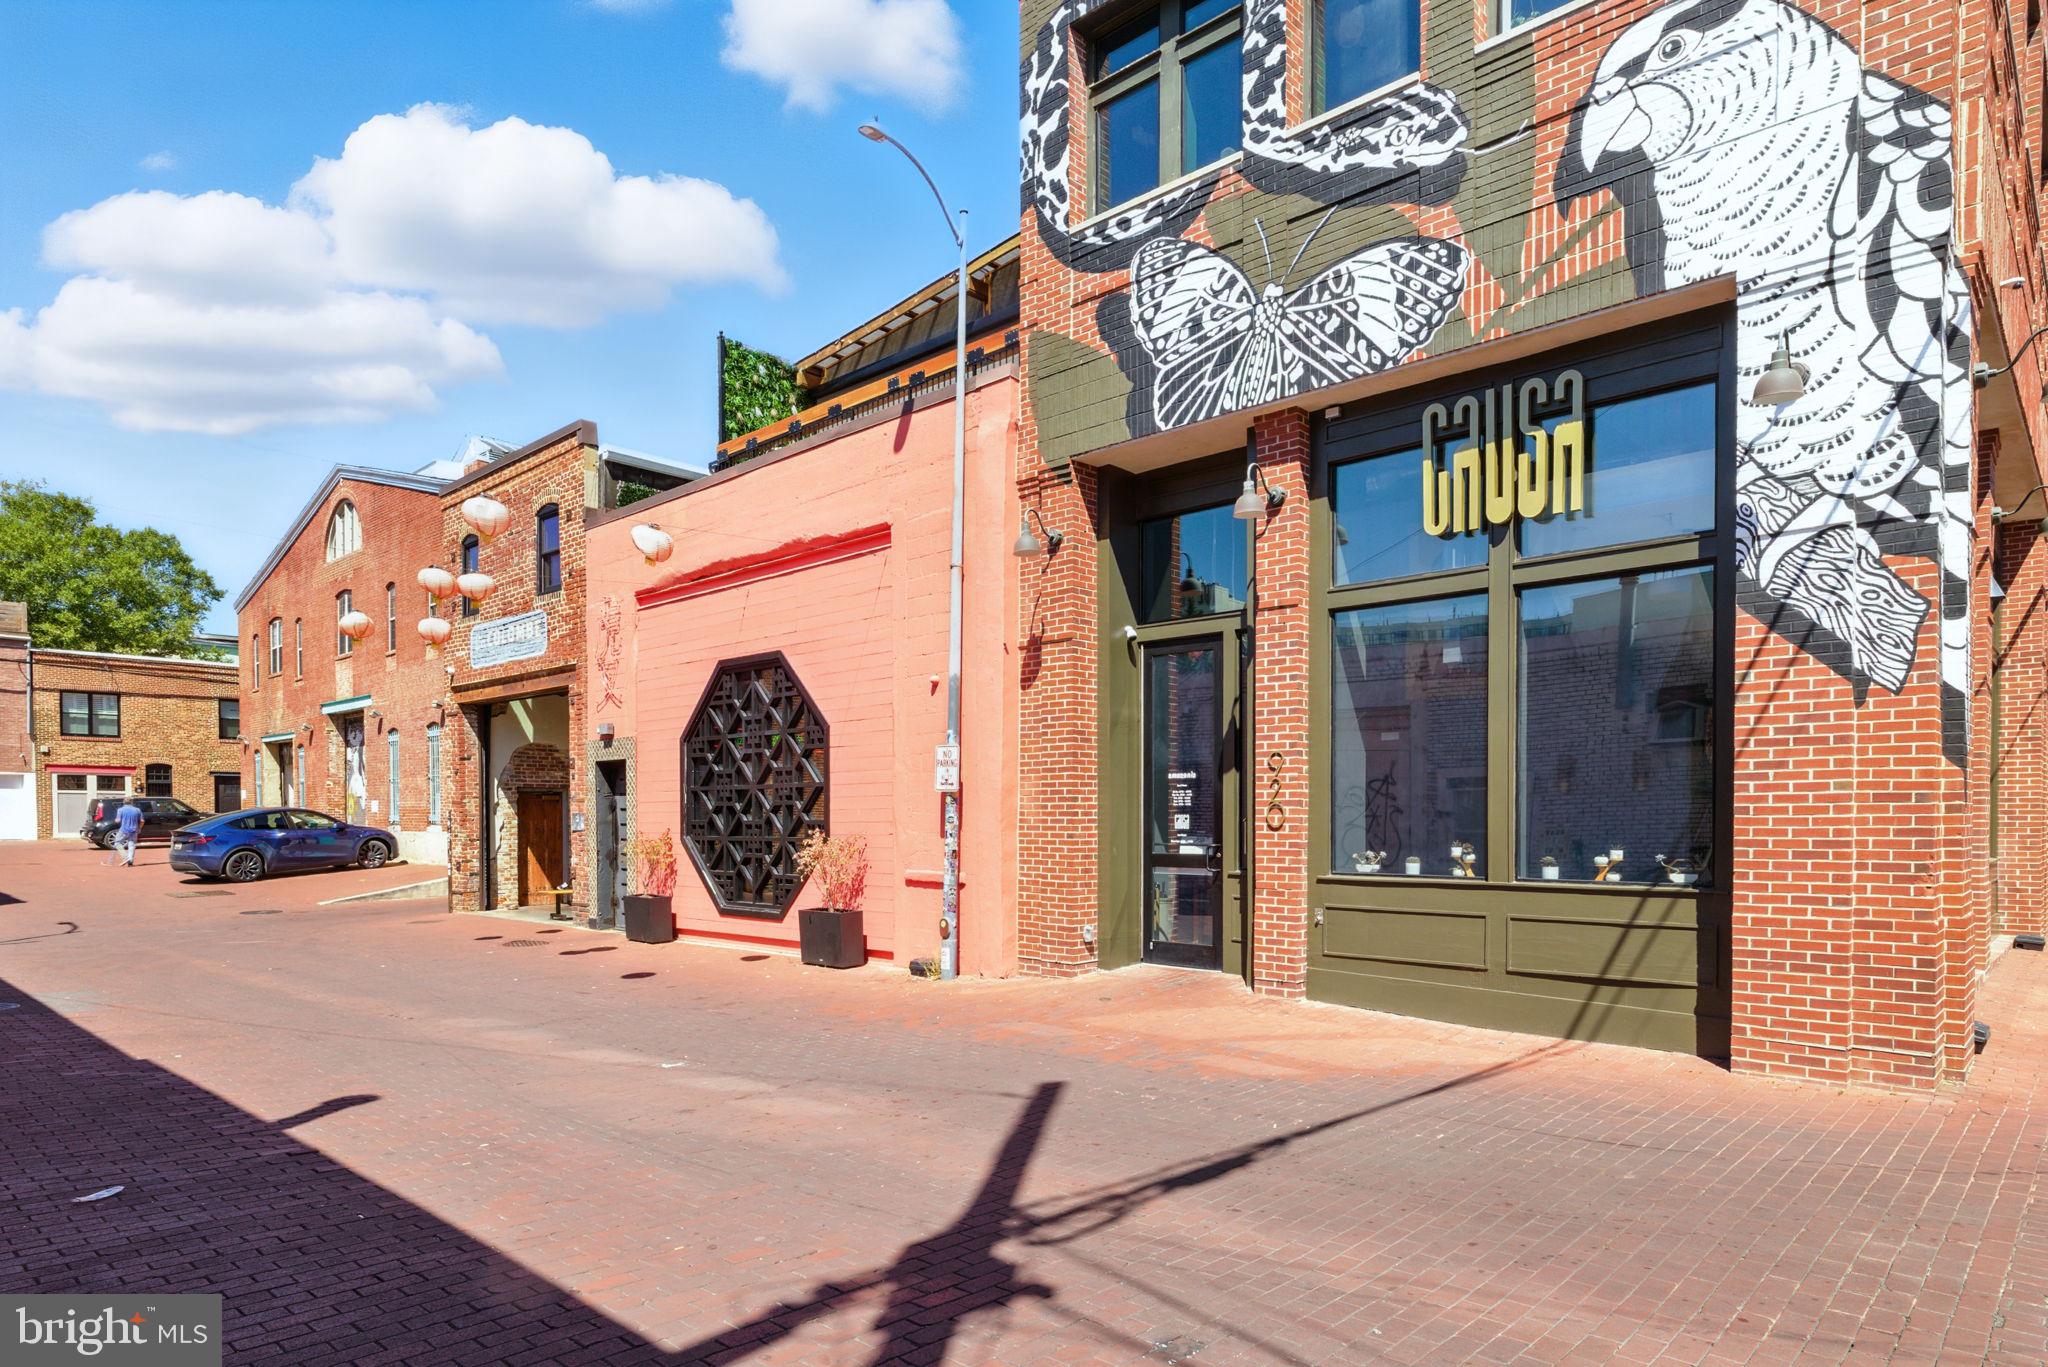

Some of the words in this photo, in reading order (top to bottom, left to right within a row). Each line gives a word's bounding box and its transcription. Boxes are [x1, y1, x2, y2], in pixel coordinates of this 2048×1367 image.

[942, 750, 952, 759] NO
[936, 759, 958, 767] PARKING
[1265, 751, 1286, 832] 920
